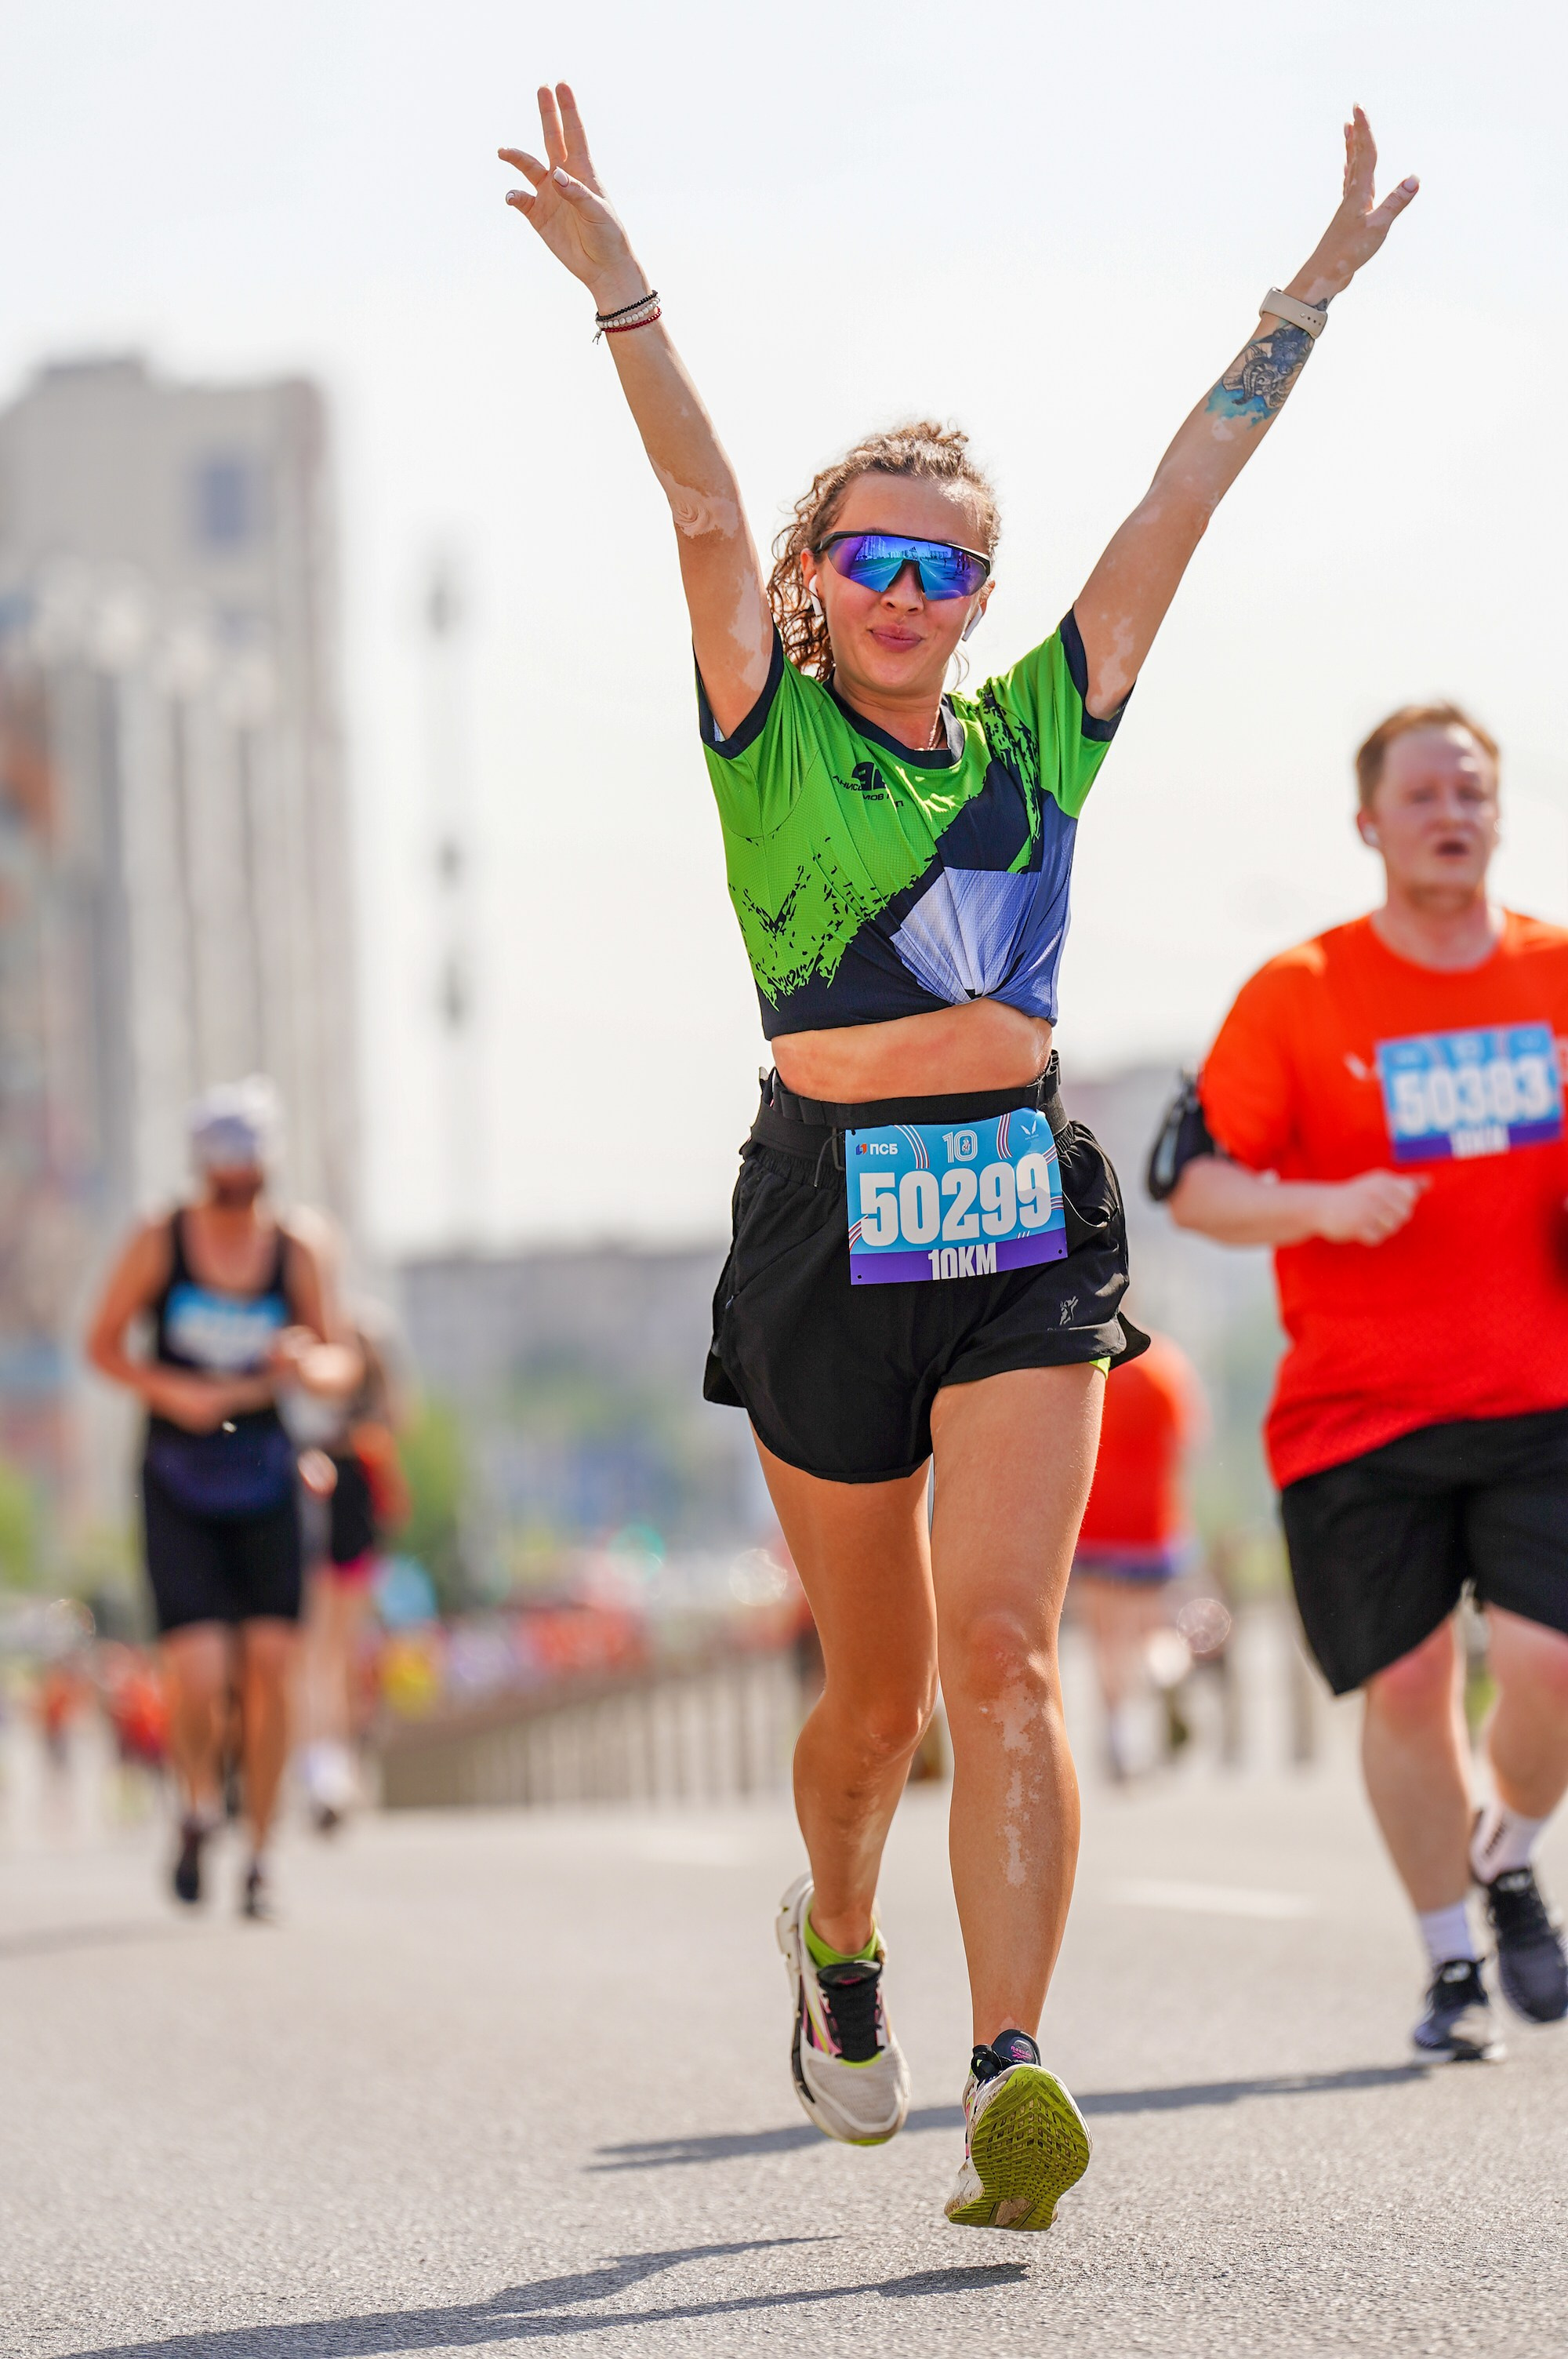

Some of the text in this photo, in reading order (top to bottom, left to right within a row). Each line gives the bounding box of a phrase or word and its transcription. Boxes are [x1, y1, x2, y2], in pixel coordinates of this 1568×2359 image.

[869, 1143, 898, 1155] ПСБ
[942, 1129, 978, 1163] 10
[859, 1153, 1051, 1247] 50299
[927, 1242, 997, 1281] 10KM
